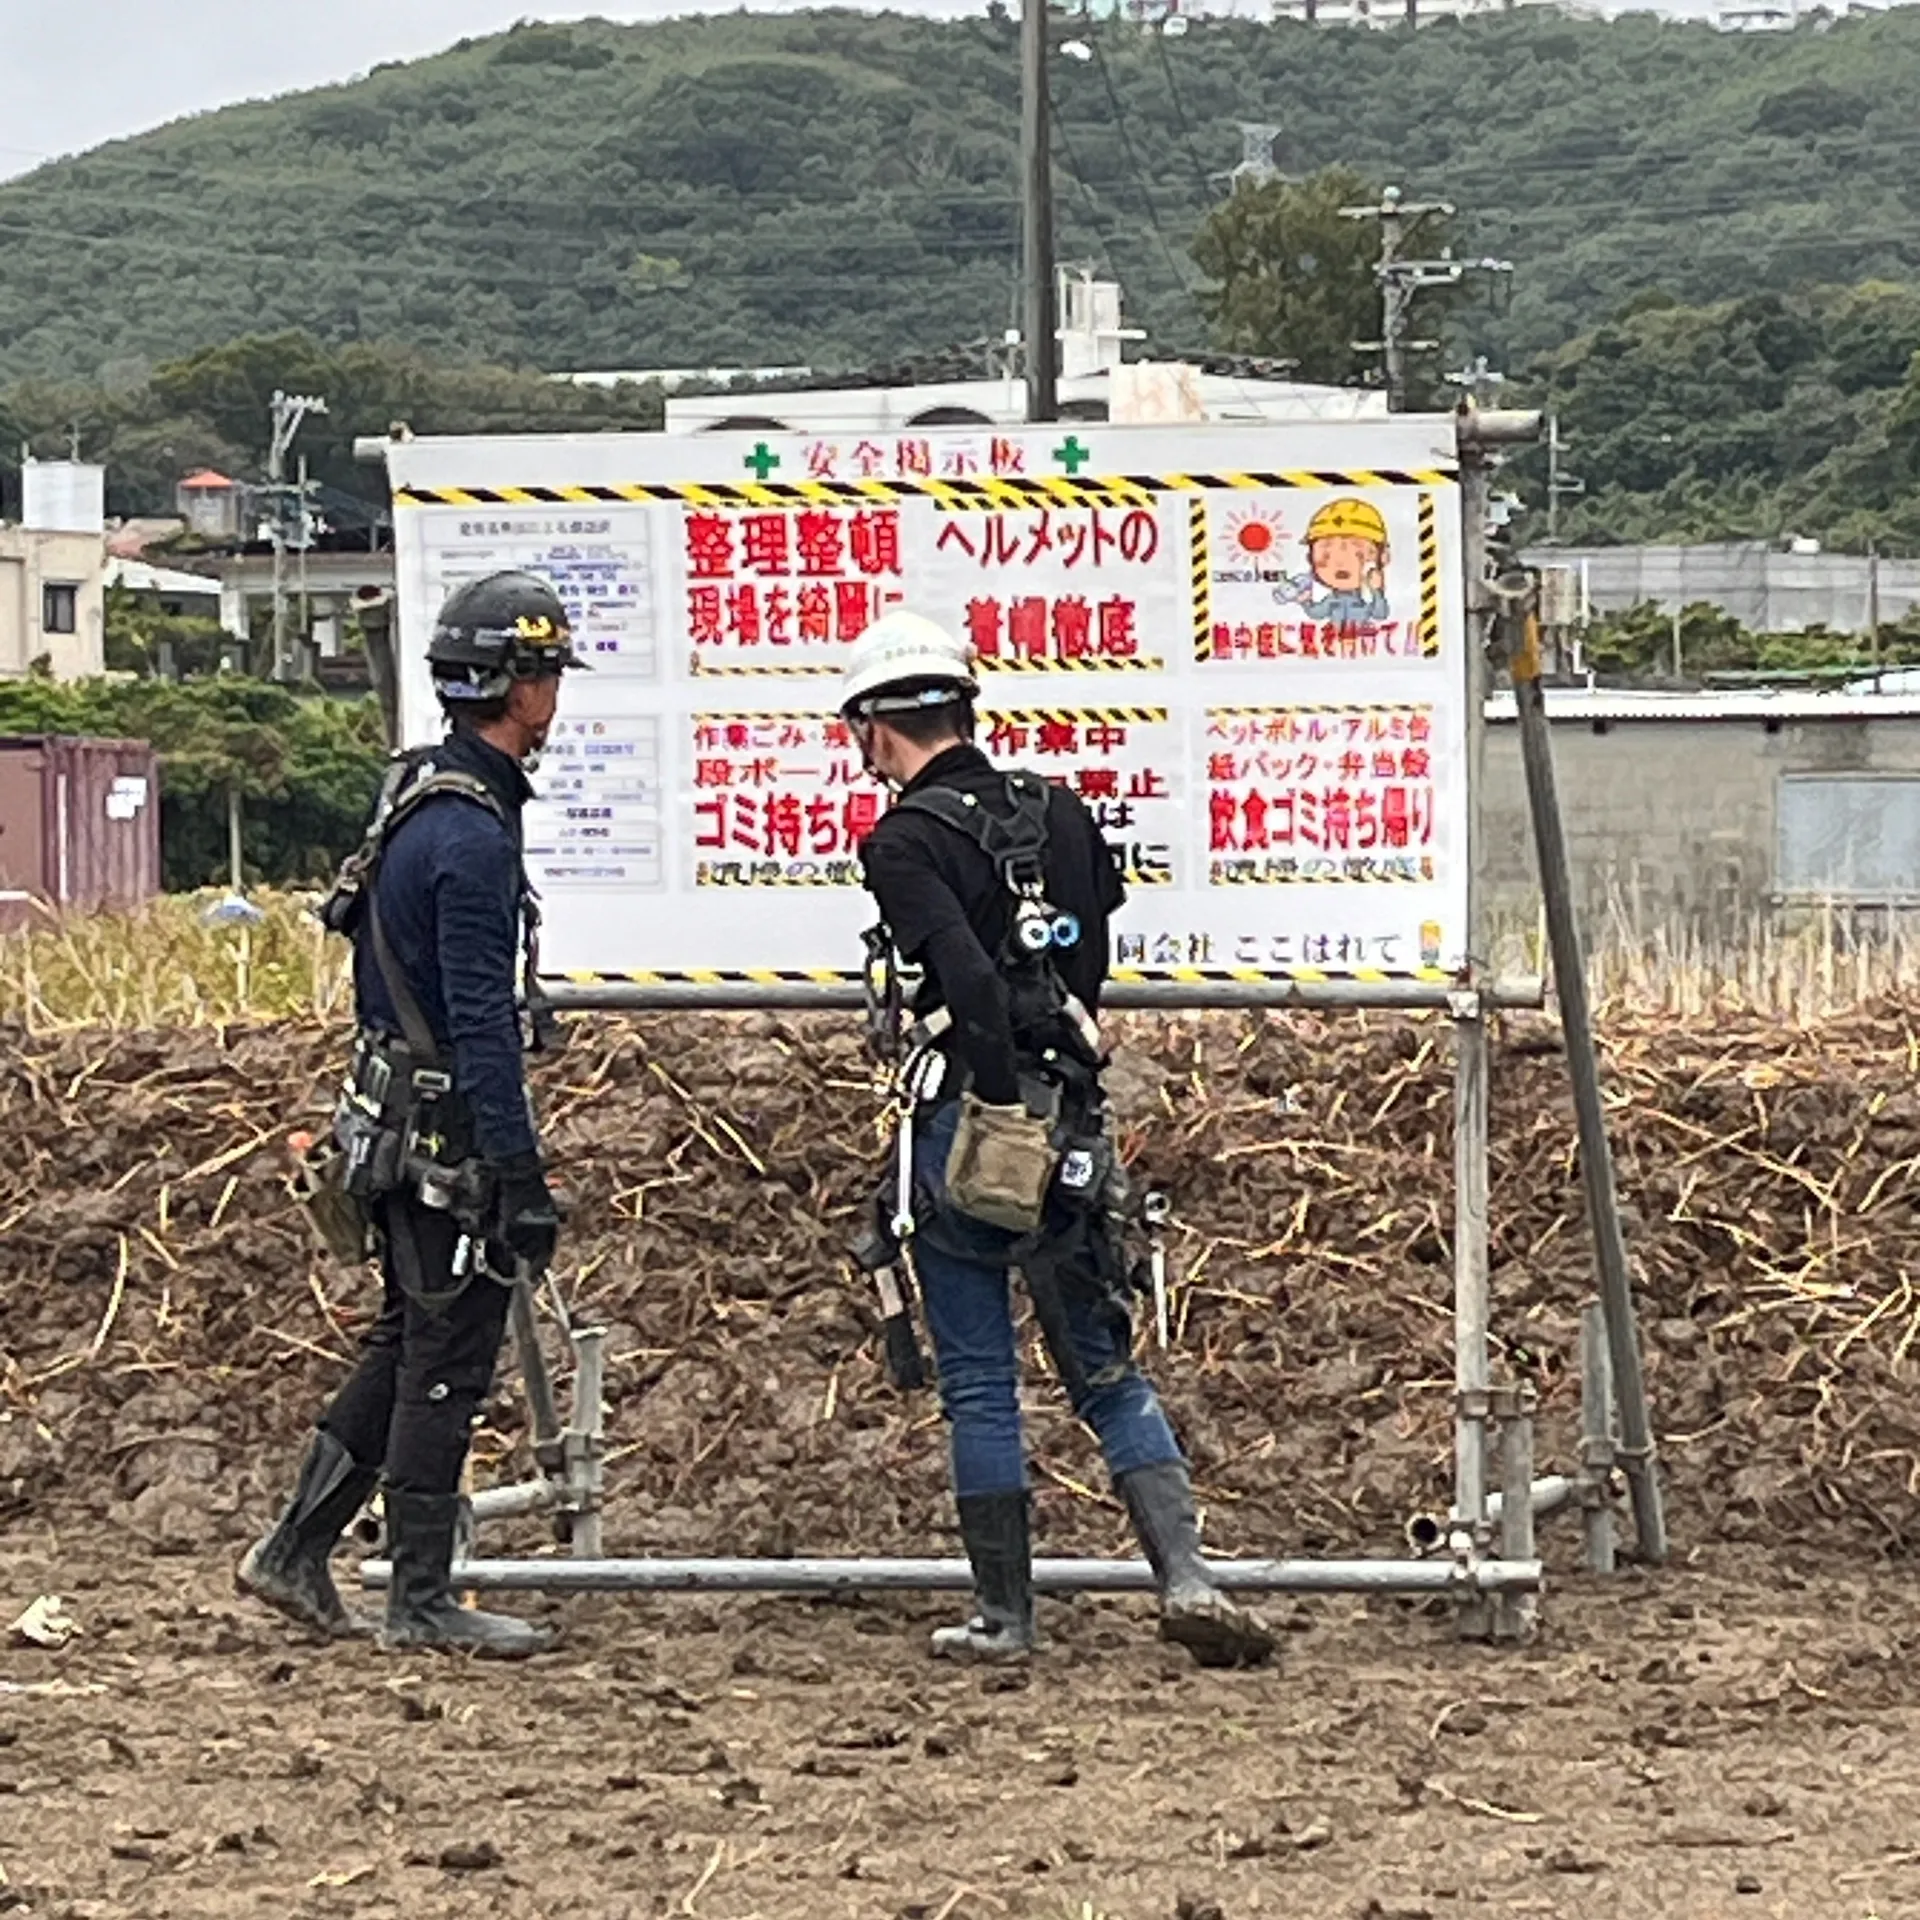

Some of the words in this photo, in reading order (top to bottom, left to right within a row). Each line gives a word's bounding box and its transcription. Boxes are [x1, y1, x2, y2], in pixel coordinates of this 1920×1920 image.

[803, 437, 1026, 479] 安全掲示板
[685, 509, 903, 578] 整理整頓
[937, 509, 1158, 568] ヘルメットの
[986, 714, 1127, 757] 作業中
[693, 758, 878, 788] 段ボール
[1209, 785, 1432, 852] 飲食ゴミ持ち帰り
[1235, 933, 1401, 963] ここはれて
